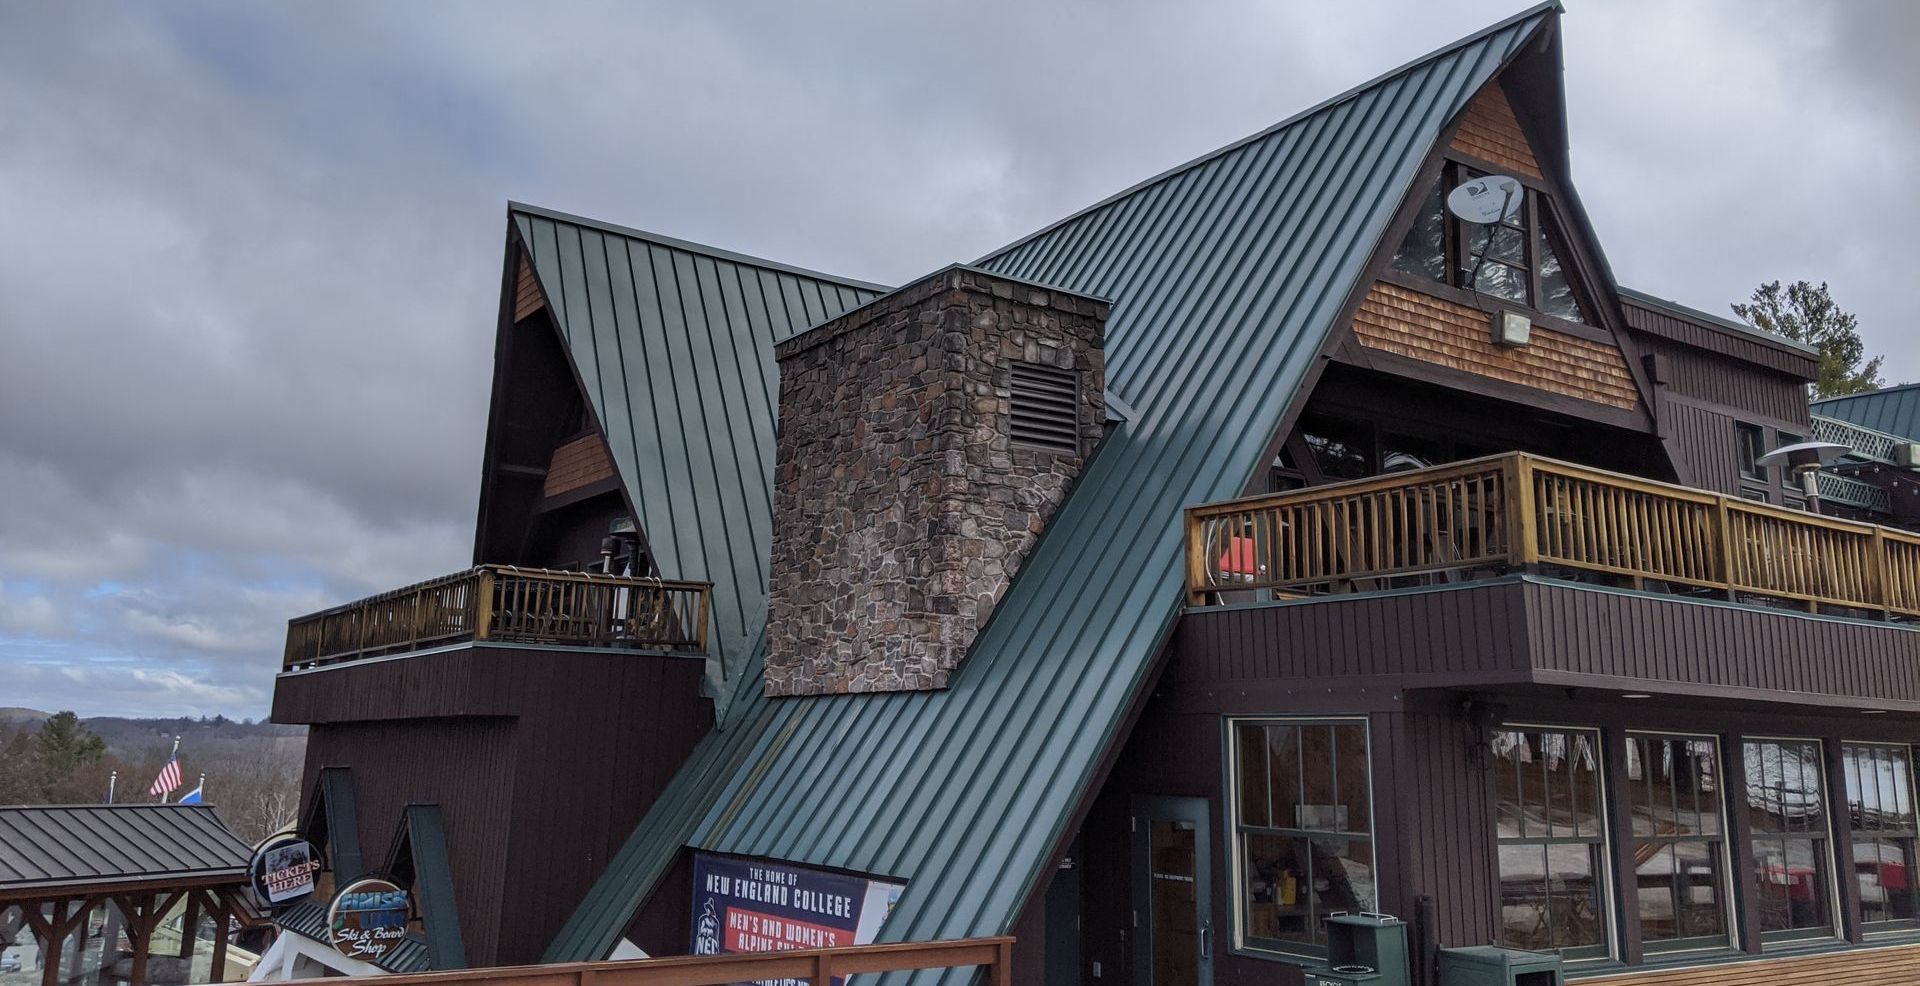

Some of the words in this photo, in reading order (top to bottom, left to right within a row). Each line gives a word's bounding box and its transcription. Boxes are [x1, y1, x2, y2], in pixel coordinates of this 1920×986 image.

[261, 859, 321, 886] TICKETS
[271, 872, 312, 892] HERE
[749, 867, 763, 881] THE
[765, 871, 785, 885] HOME
[788, 873, 798, 886] OF
[706, 874, 731, 896] NEW
[734, 878, 788, 906] ENGLAND
[793, 889, 852, 919] COLLEGE
[334, 928, 359, 943] Ski
[372, 926, 405, 939] Board
[729, 911, 759, 934] MEN'S
[762, 918, 782, 939] AND
[785, 923, 836, 948] WOMEN'S
[346, 939, 387, 959] Shop
[738, 933, 773, 952] ALPINE
